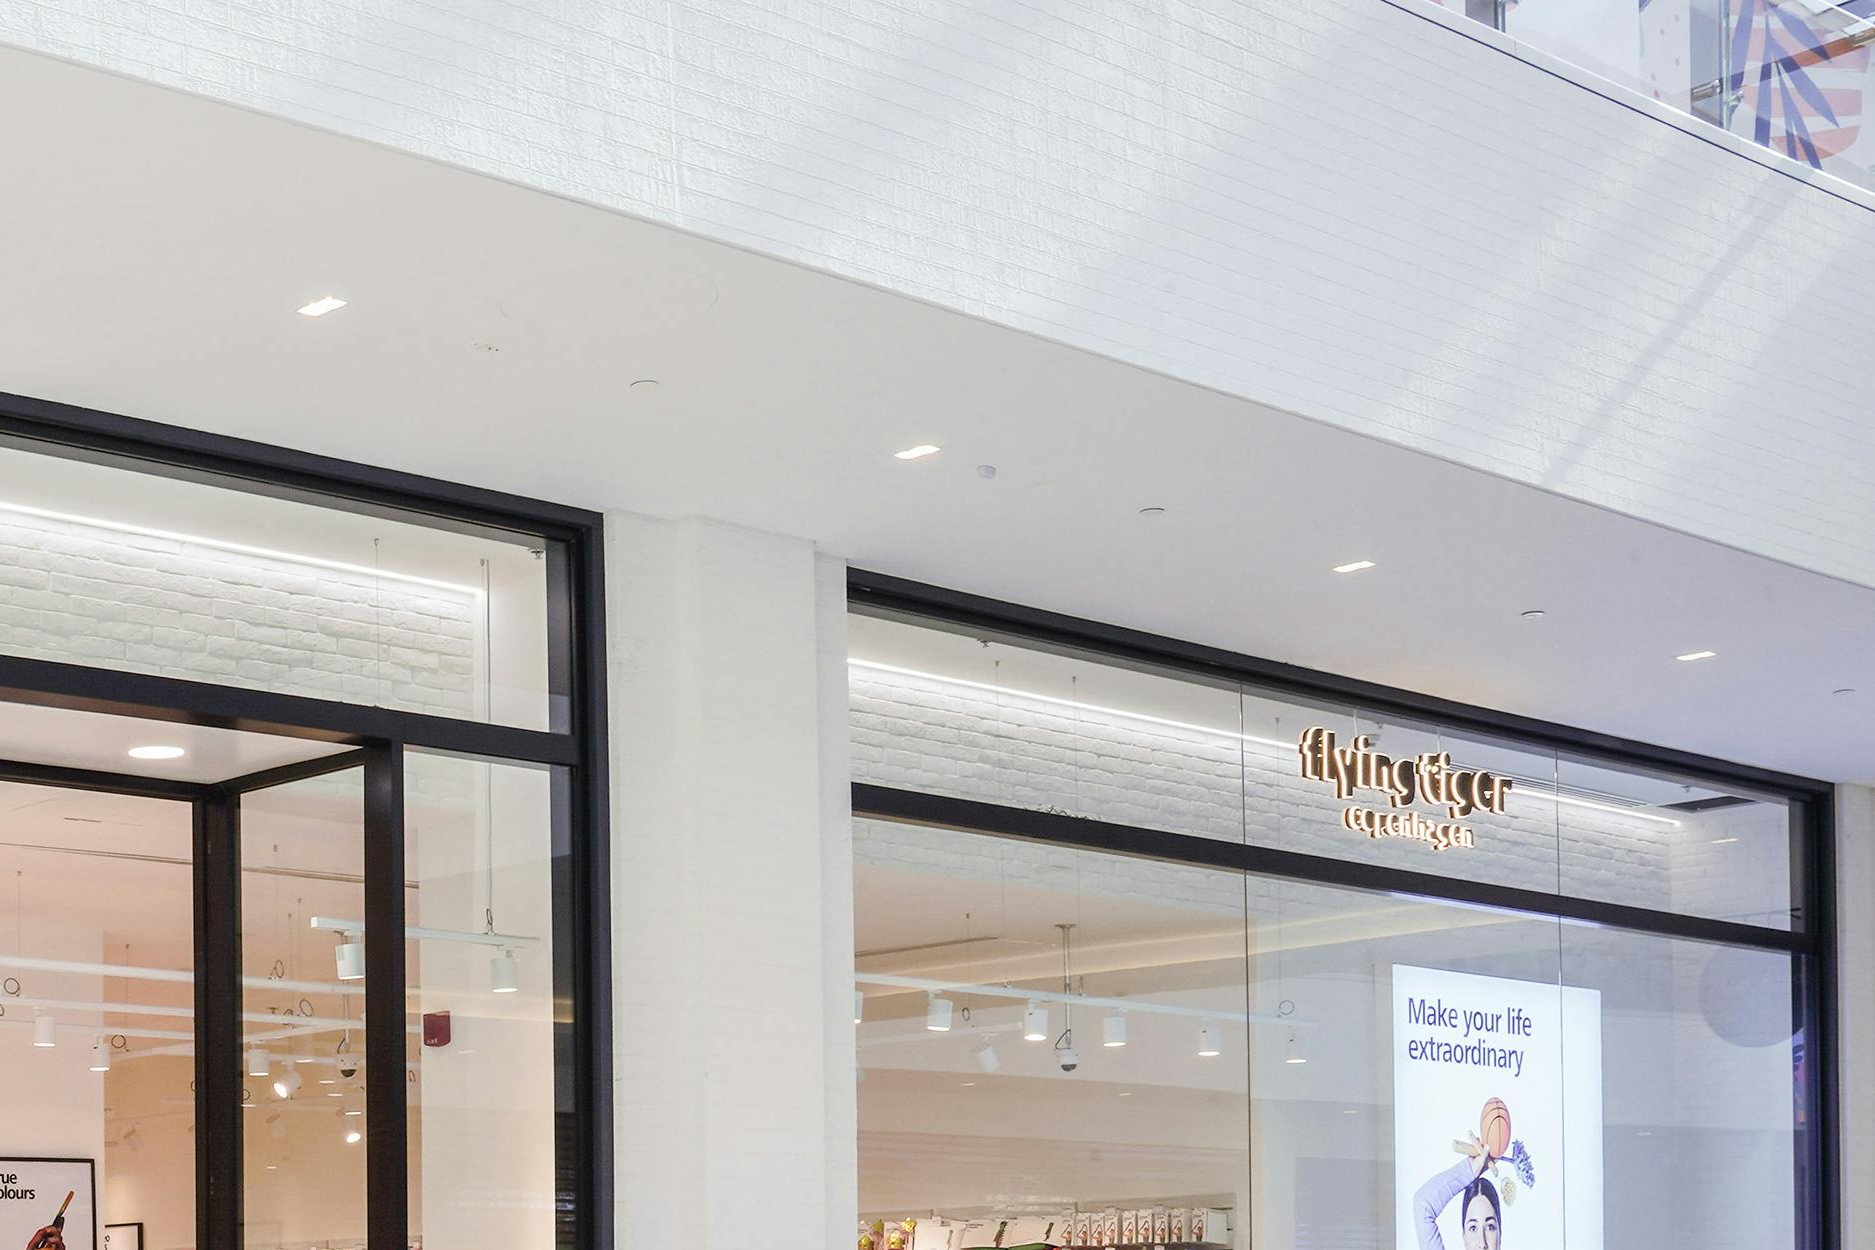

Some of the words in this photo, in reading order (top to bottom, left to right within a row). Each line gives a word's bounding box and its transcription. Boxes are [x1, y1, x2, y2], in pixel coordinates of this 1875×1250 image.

[1298, 726, 1416, 809] flying
[1415, 751, 1513, 820] tiger
[1407, 996, 1459, 1029] Make
[1463, 1007, 1502, 1038] your
[1506, 1006, 1533, 1038] life
[1407, 1036, 1525, 1078] extraordinary
